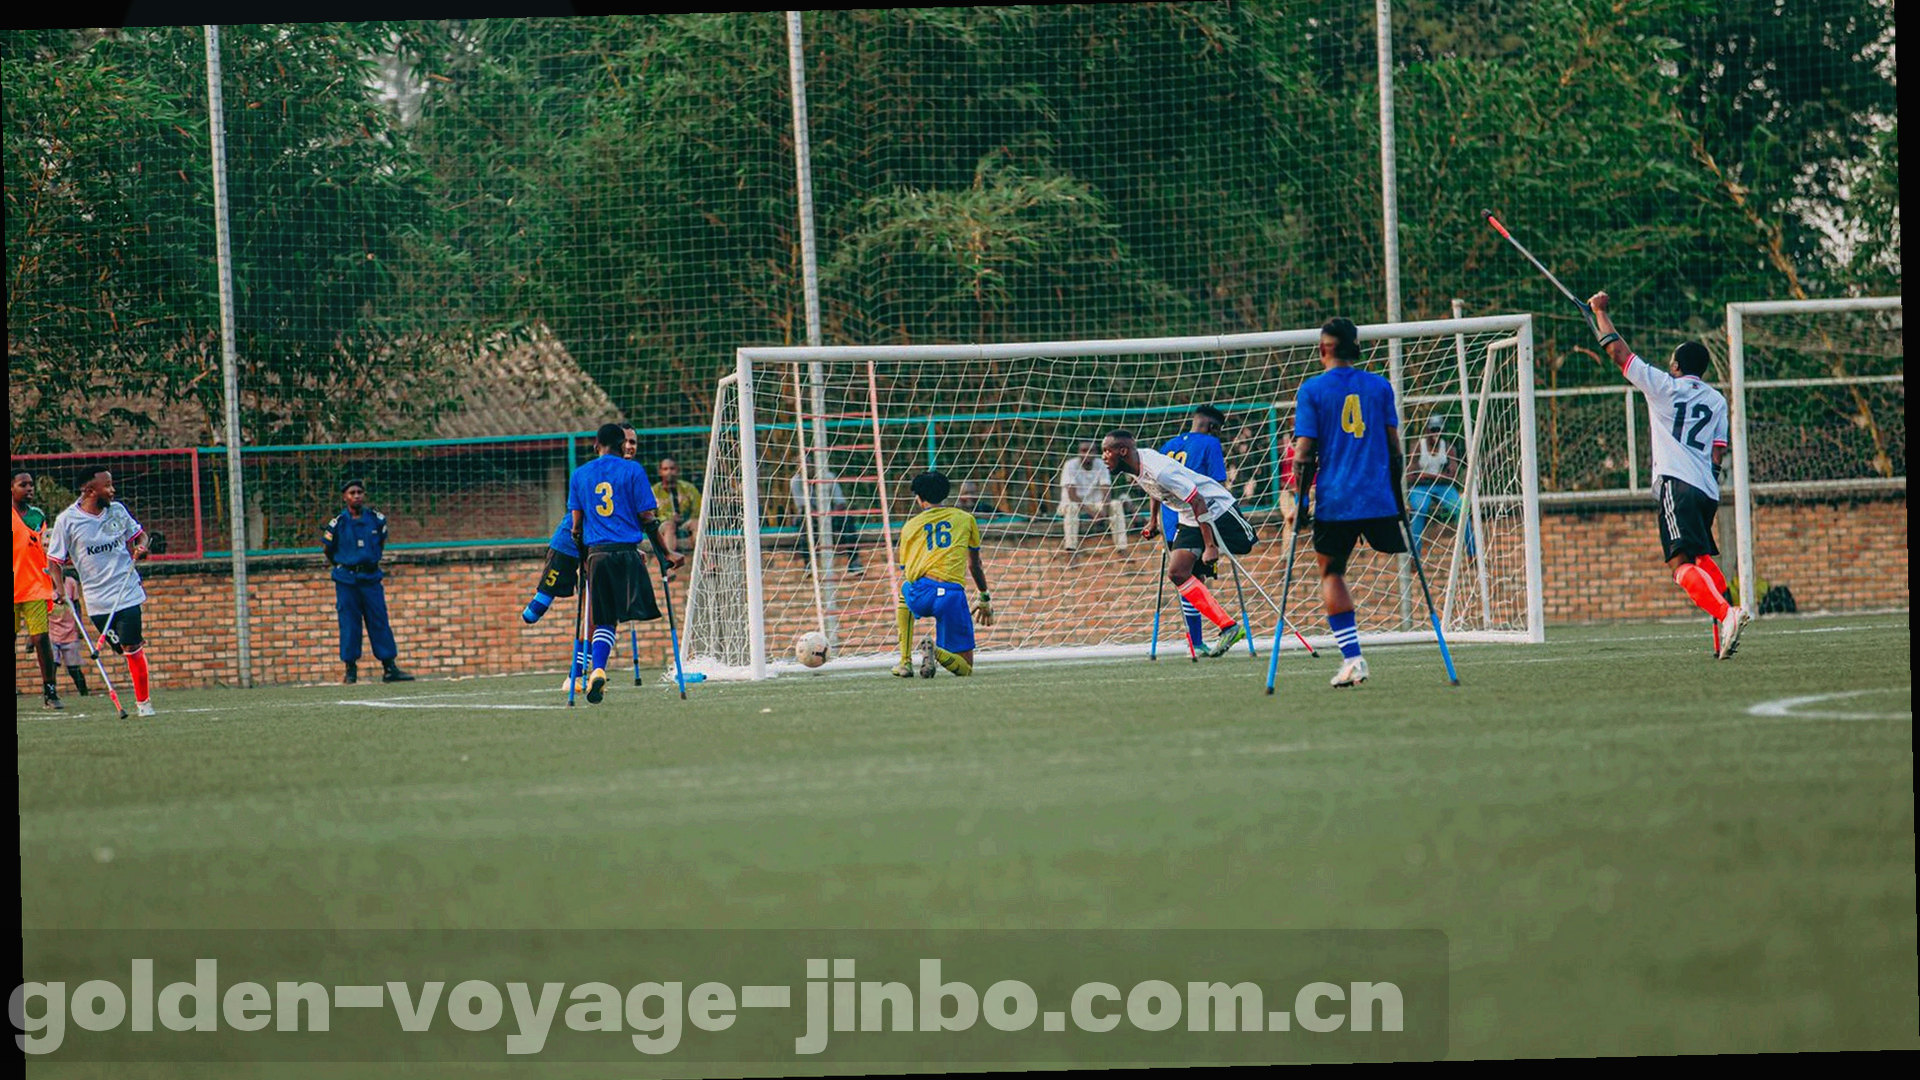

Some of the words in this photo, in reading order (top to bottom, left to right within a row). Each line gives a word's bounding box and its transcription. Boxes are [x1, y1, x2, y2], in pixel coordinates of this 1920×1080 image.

[1341, 394, 1366, 438] 4
[1672, 402, 1713, 451] 12
[595, 481, 614, 517] 3
[924, 520, 952, 551] 16
[545, 569, 560, 587] 5
[107, 629, 120, 644] 8
